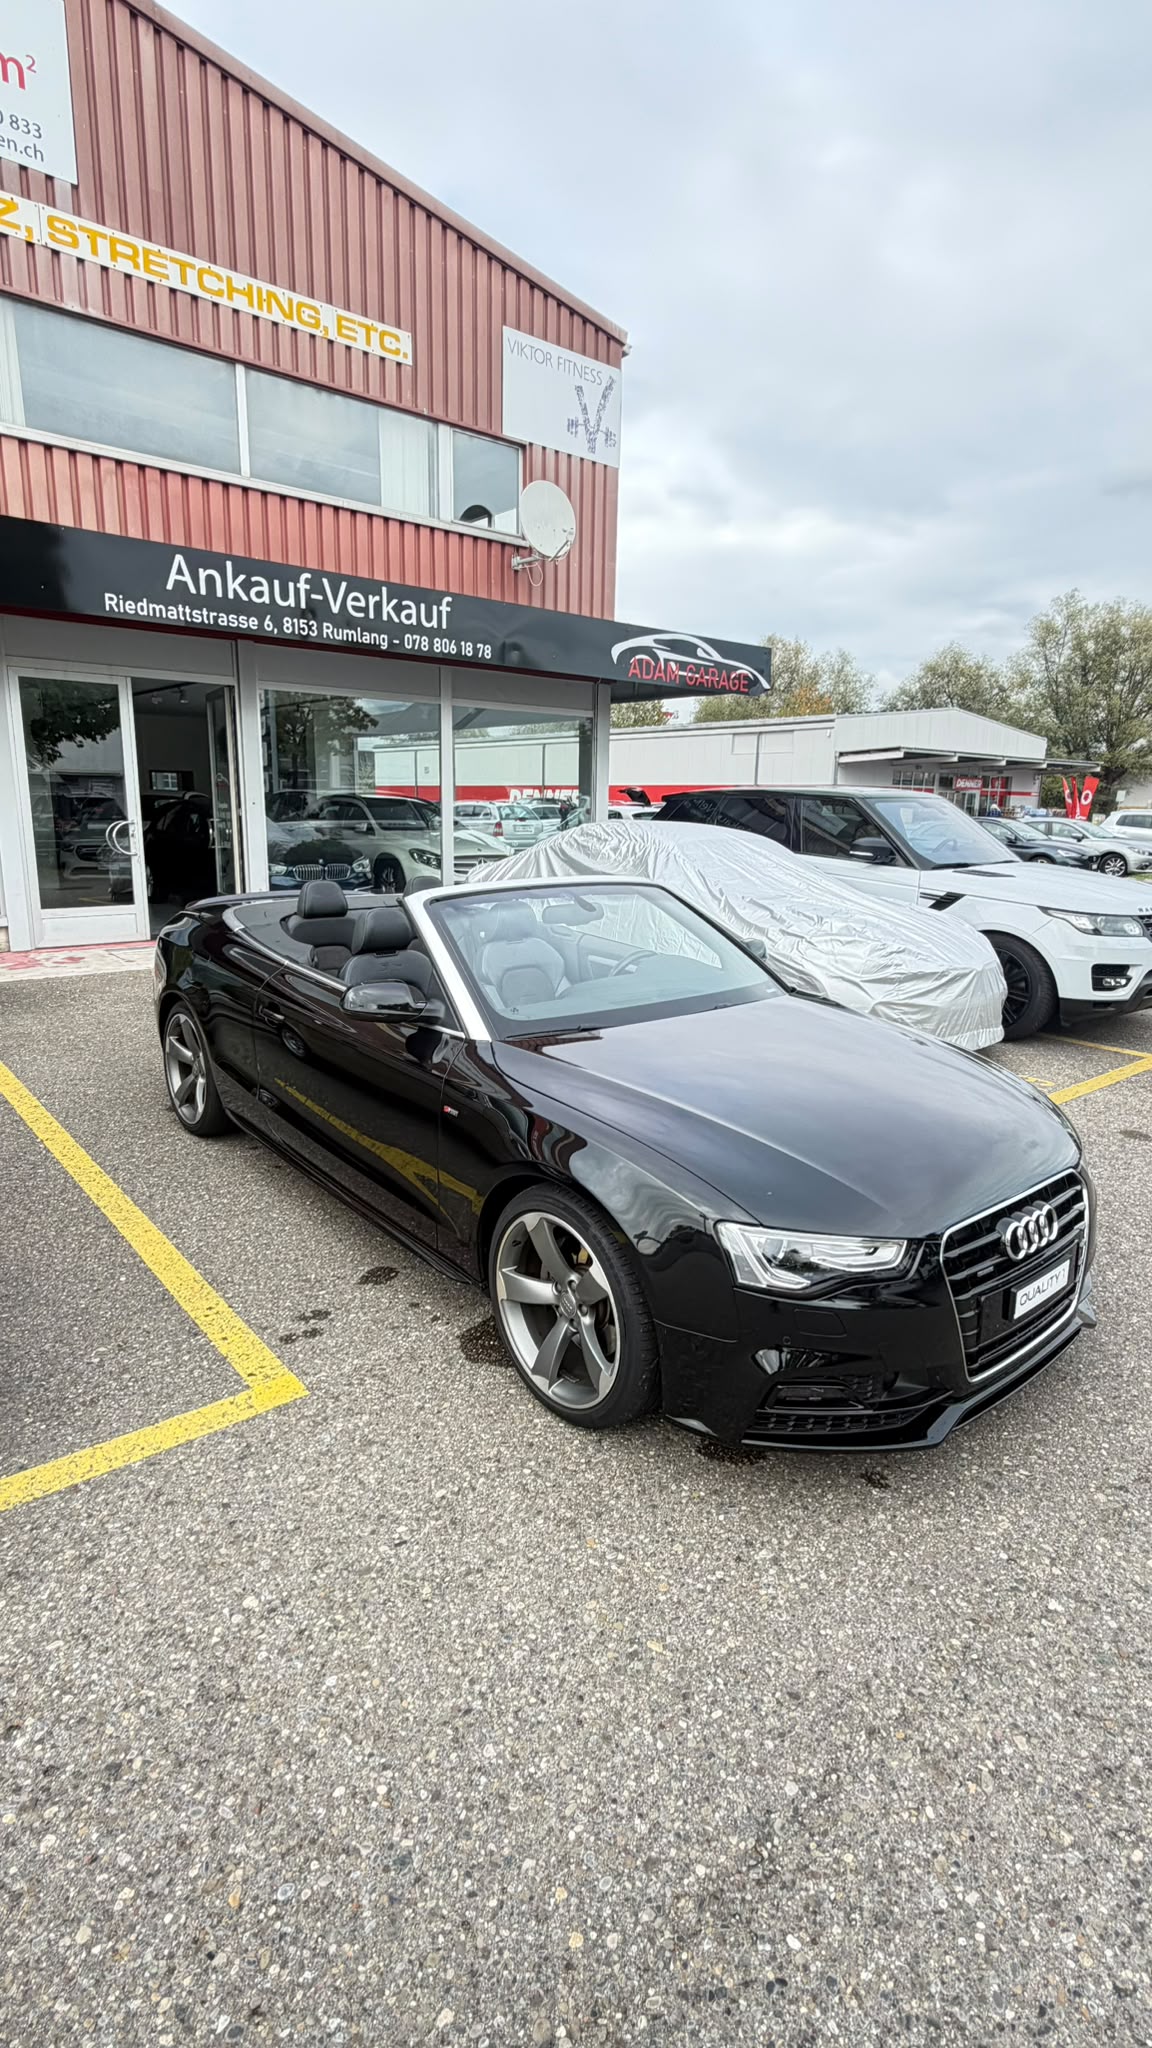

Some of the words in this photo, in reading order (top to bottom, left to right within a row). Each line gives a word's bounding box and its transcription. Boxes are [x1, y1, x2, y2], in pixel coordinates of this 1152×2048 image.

[9, 113, 42, 139] 833
[47, 214, 329, 339] STRETCHING,
[336, 313, 408, 360] ETC.
[507, 337, 553, 369] VIKTOR
[557, 355, 603, 386] FITNESS
[166, 554, 452, 629] Ankauf-Verkauf
[104, 592, 258, 630] Riedmattstrasse
[264, 614, 278, 634] 6,
[282, 617, 318, 637] 8153
[323, 622, 388, 650] Rumlang
[404, 633, 429, 652] 078
[434, 638, 457, 655] 806
[460, 641, 473, 657] 18
[477, 643, 492, 659] 78
[628, 656, 680, 685] ADAM
[685, 664, 749, 692] GARAGE
[956, 778, 983, 788] DENNER
[1019, 1270, 1061, 1306] QUALITY
